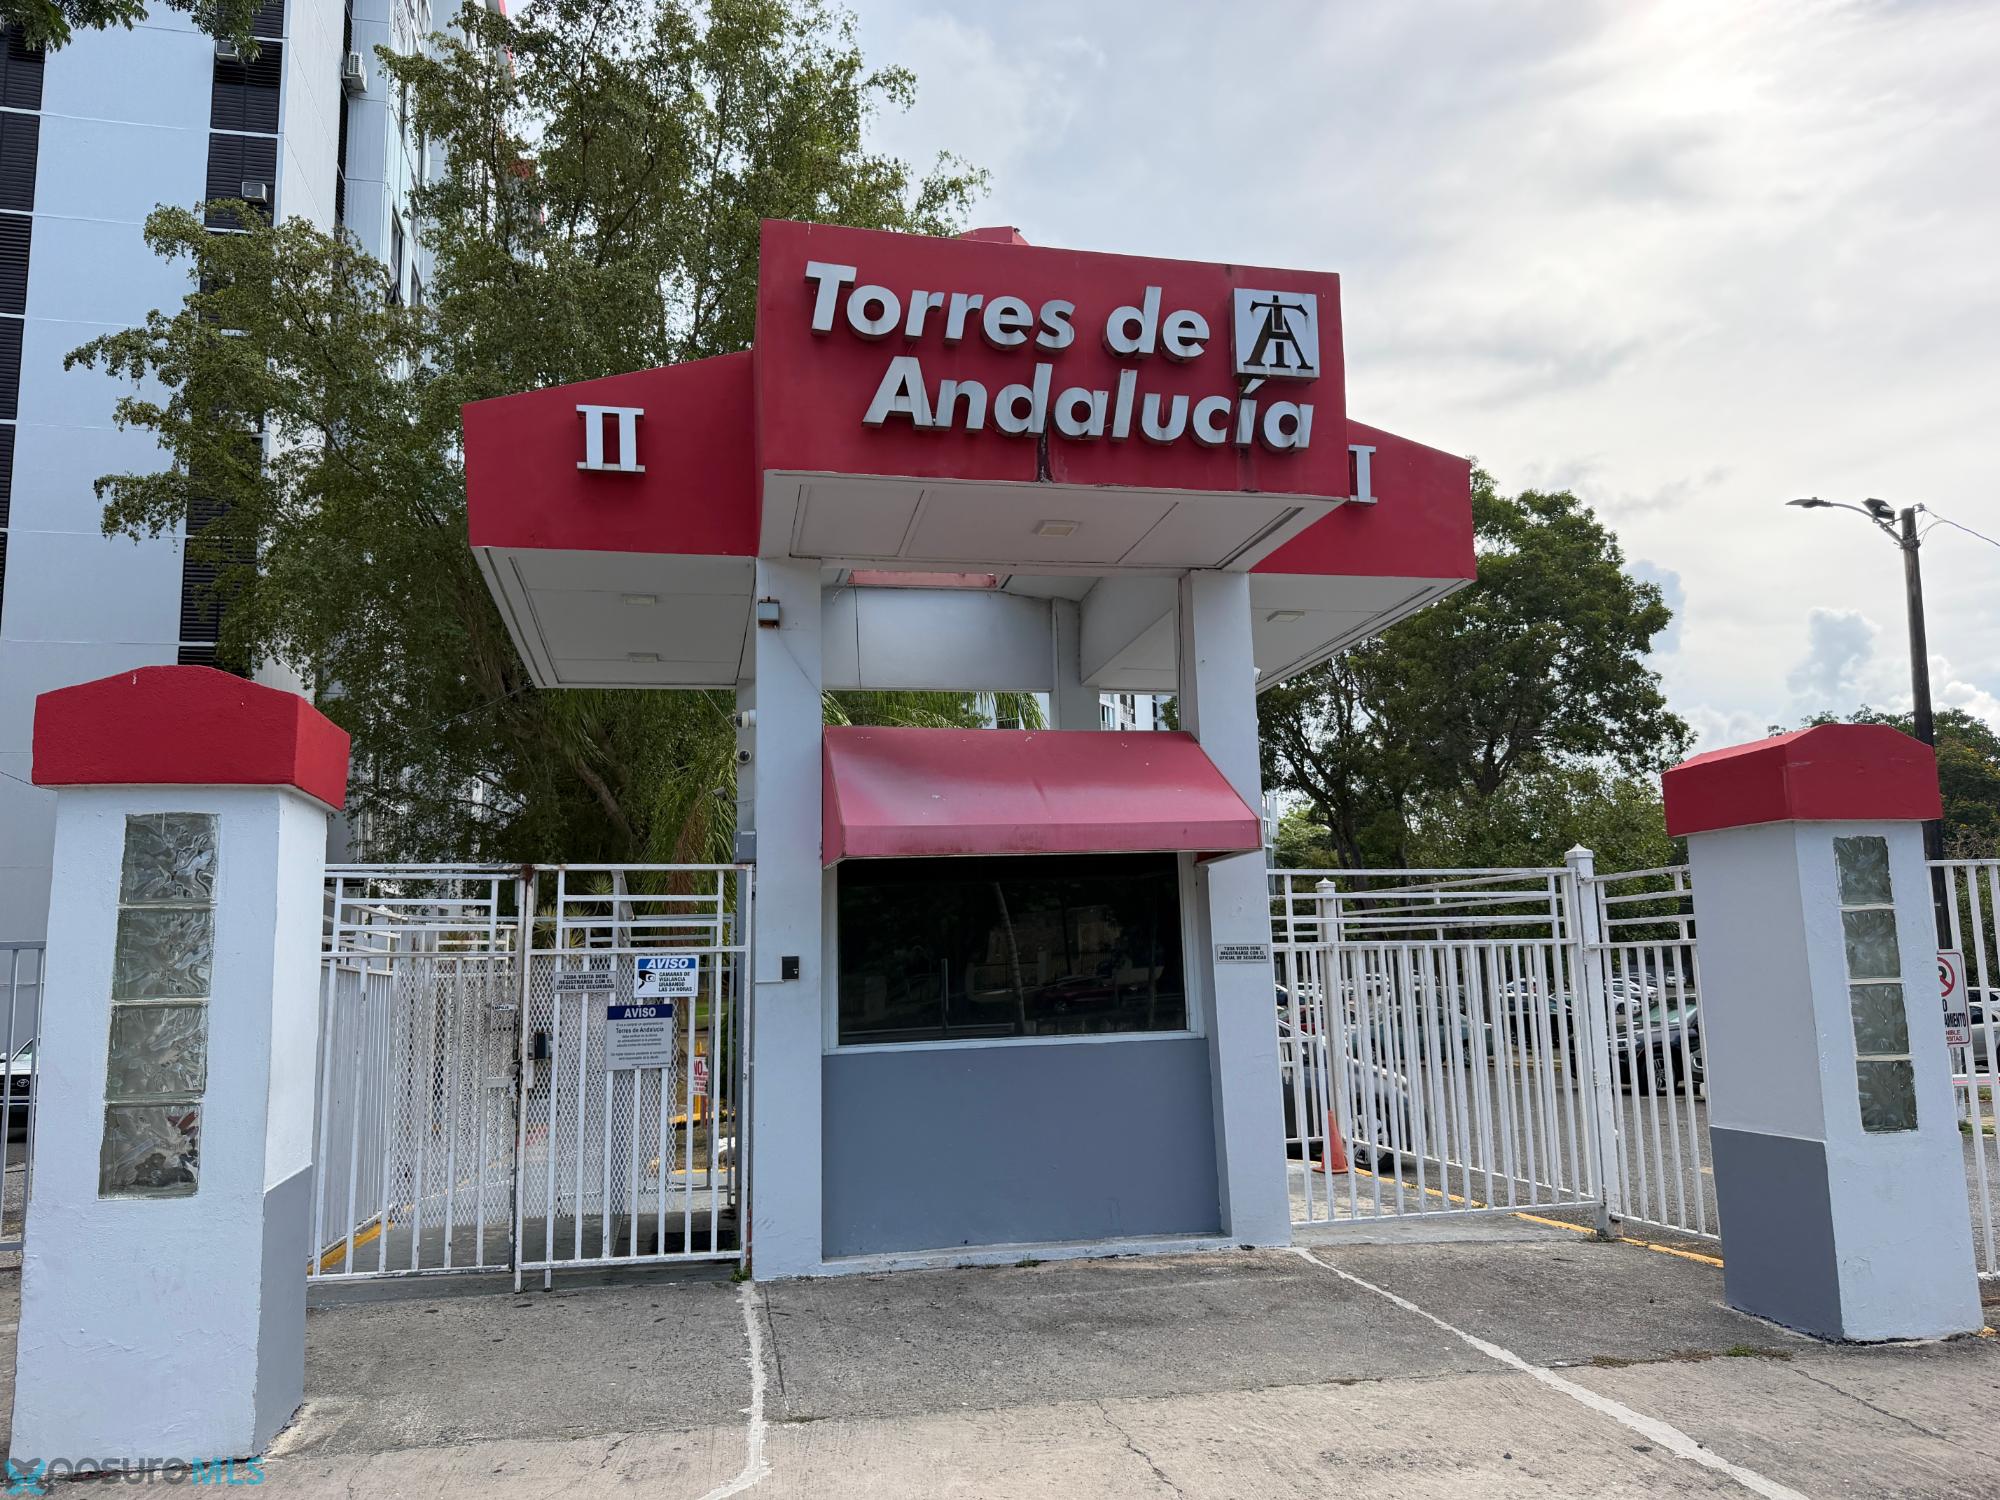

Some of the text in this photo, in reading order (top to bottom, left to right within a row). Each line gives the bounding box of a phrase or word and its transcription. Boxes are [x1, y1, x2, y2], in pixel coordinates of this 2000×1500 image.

[804, 261, 1211, 361] Torres de
[862, 356, 1314, 453] Andalucía
[576, 405, 646, 473] II
[646, 958, 689, 969] AVISO
[624, 1007, 656, 1018] AVISO
